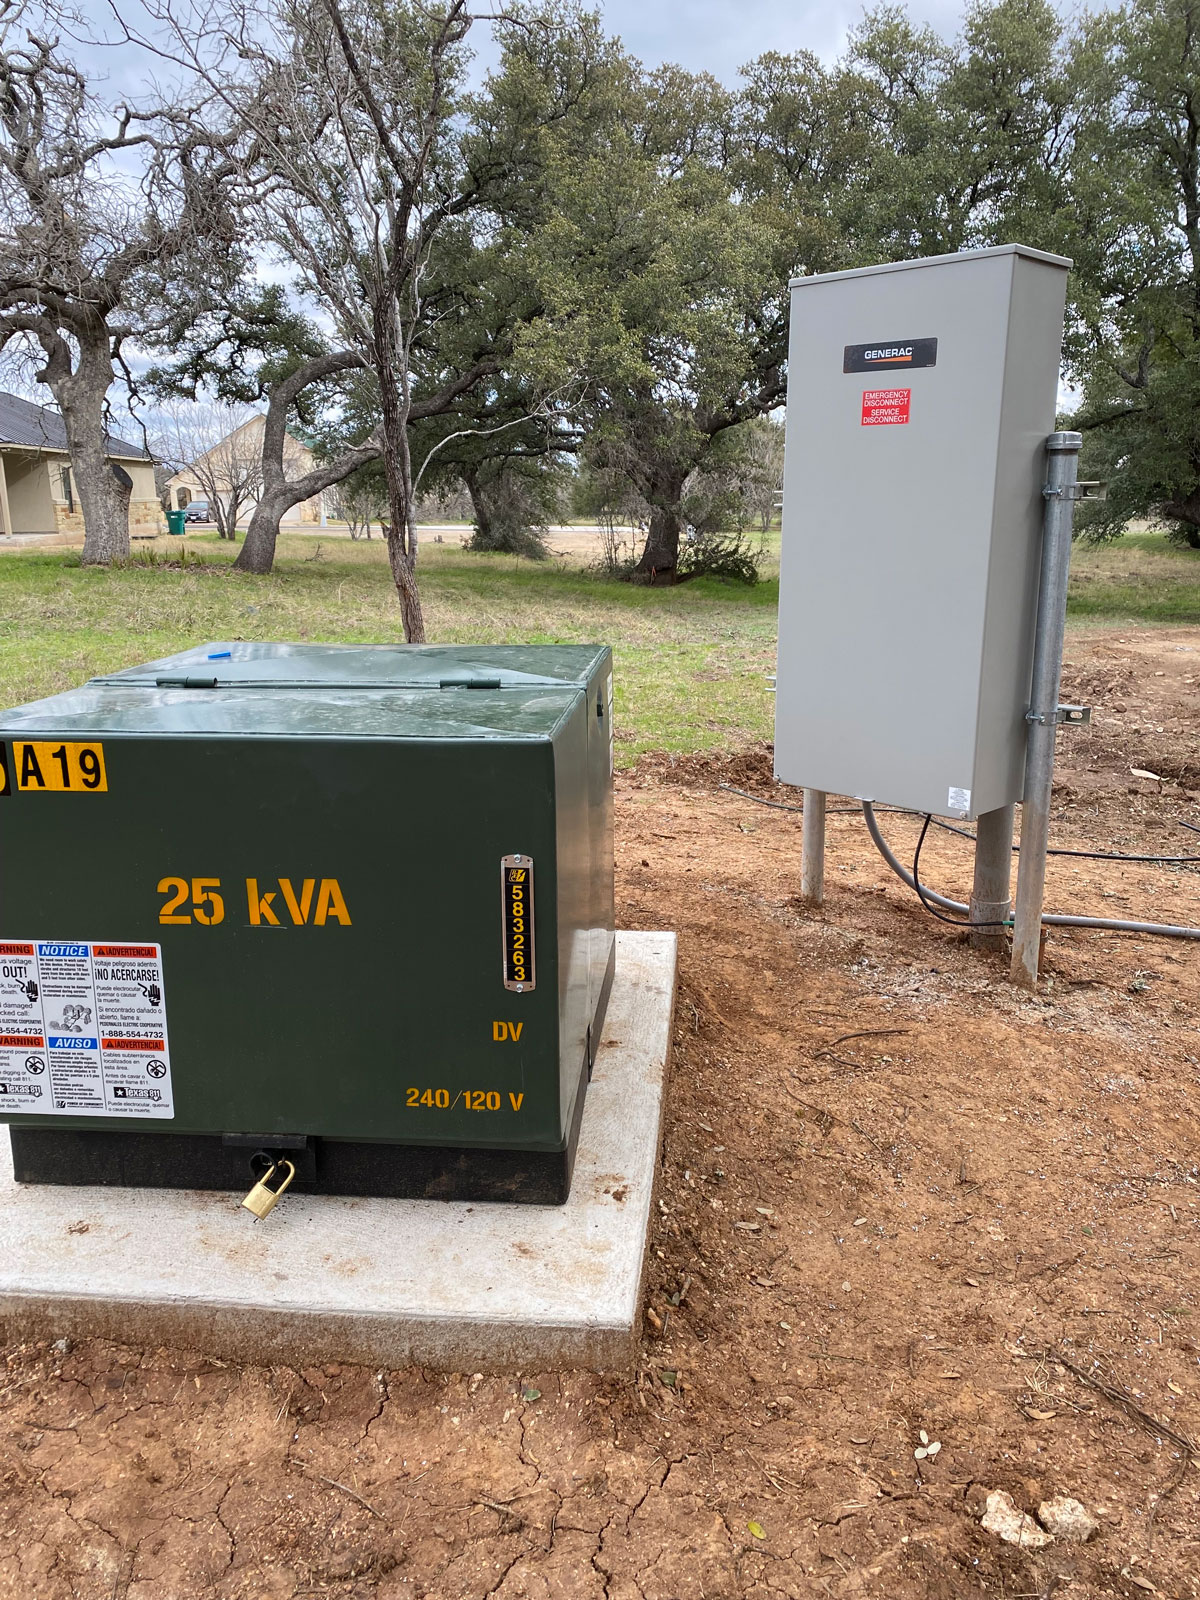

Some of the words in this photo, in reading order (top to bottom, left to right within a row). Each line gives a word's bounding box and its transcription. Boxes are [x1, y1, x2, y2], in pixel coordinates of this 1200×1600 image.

[864, 347, 913, 359] GENERAC
[865, 391, 908, 400] EMERGENCY
[864, 398, 908, 407] DISCONNECT
[871, 408, 900, 416] SERVICE
[863, 415, 907, 423] DISCONNECT
[21, 745, 101, 789] A19
[157, 877, 225, 925] 25
[246, 878, 352, 925] kVA
[41, 946, 85, 955] NOTICE
[3, 966, 27, 978] OUT!
[95, 969, 108, 980] ¡NO
[111, 969, 159, 981] ACERCARSE!
[101, 1030, 163, 1038] 1-888-554-4732
[493, 1021, 523, 1041] DV
[56, 1039, 91, 1048] AVISO
[5, 1084, 30, 1092] Texas
[124, 1088, 148, 1097] Texas
[149, 1089, 160, 1097] 811
[406, 1088, 501, 1111] 240/120
[509, 1092, 524, 1111] V
